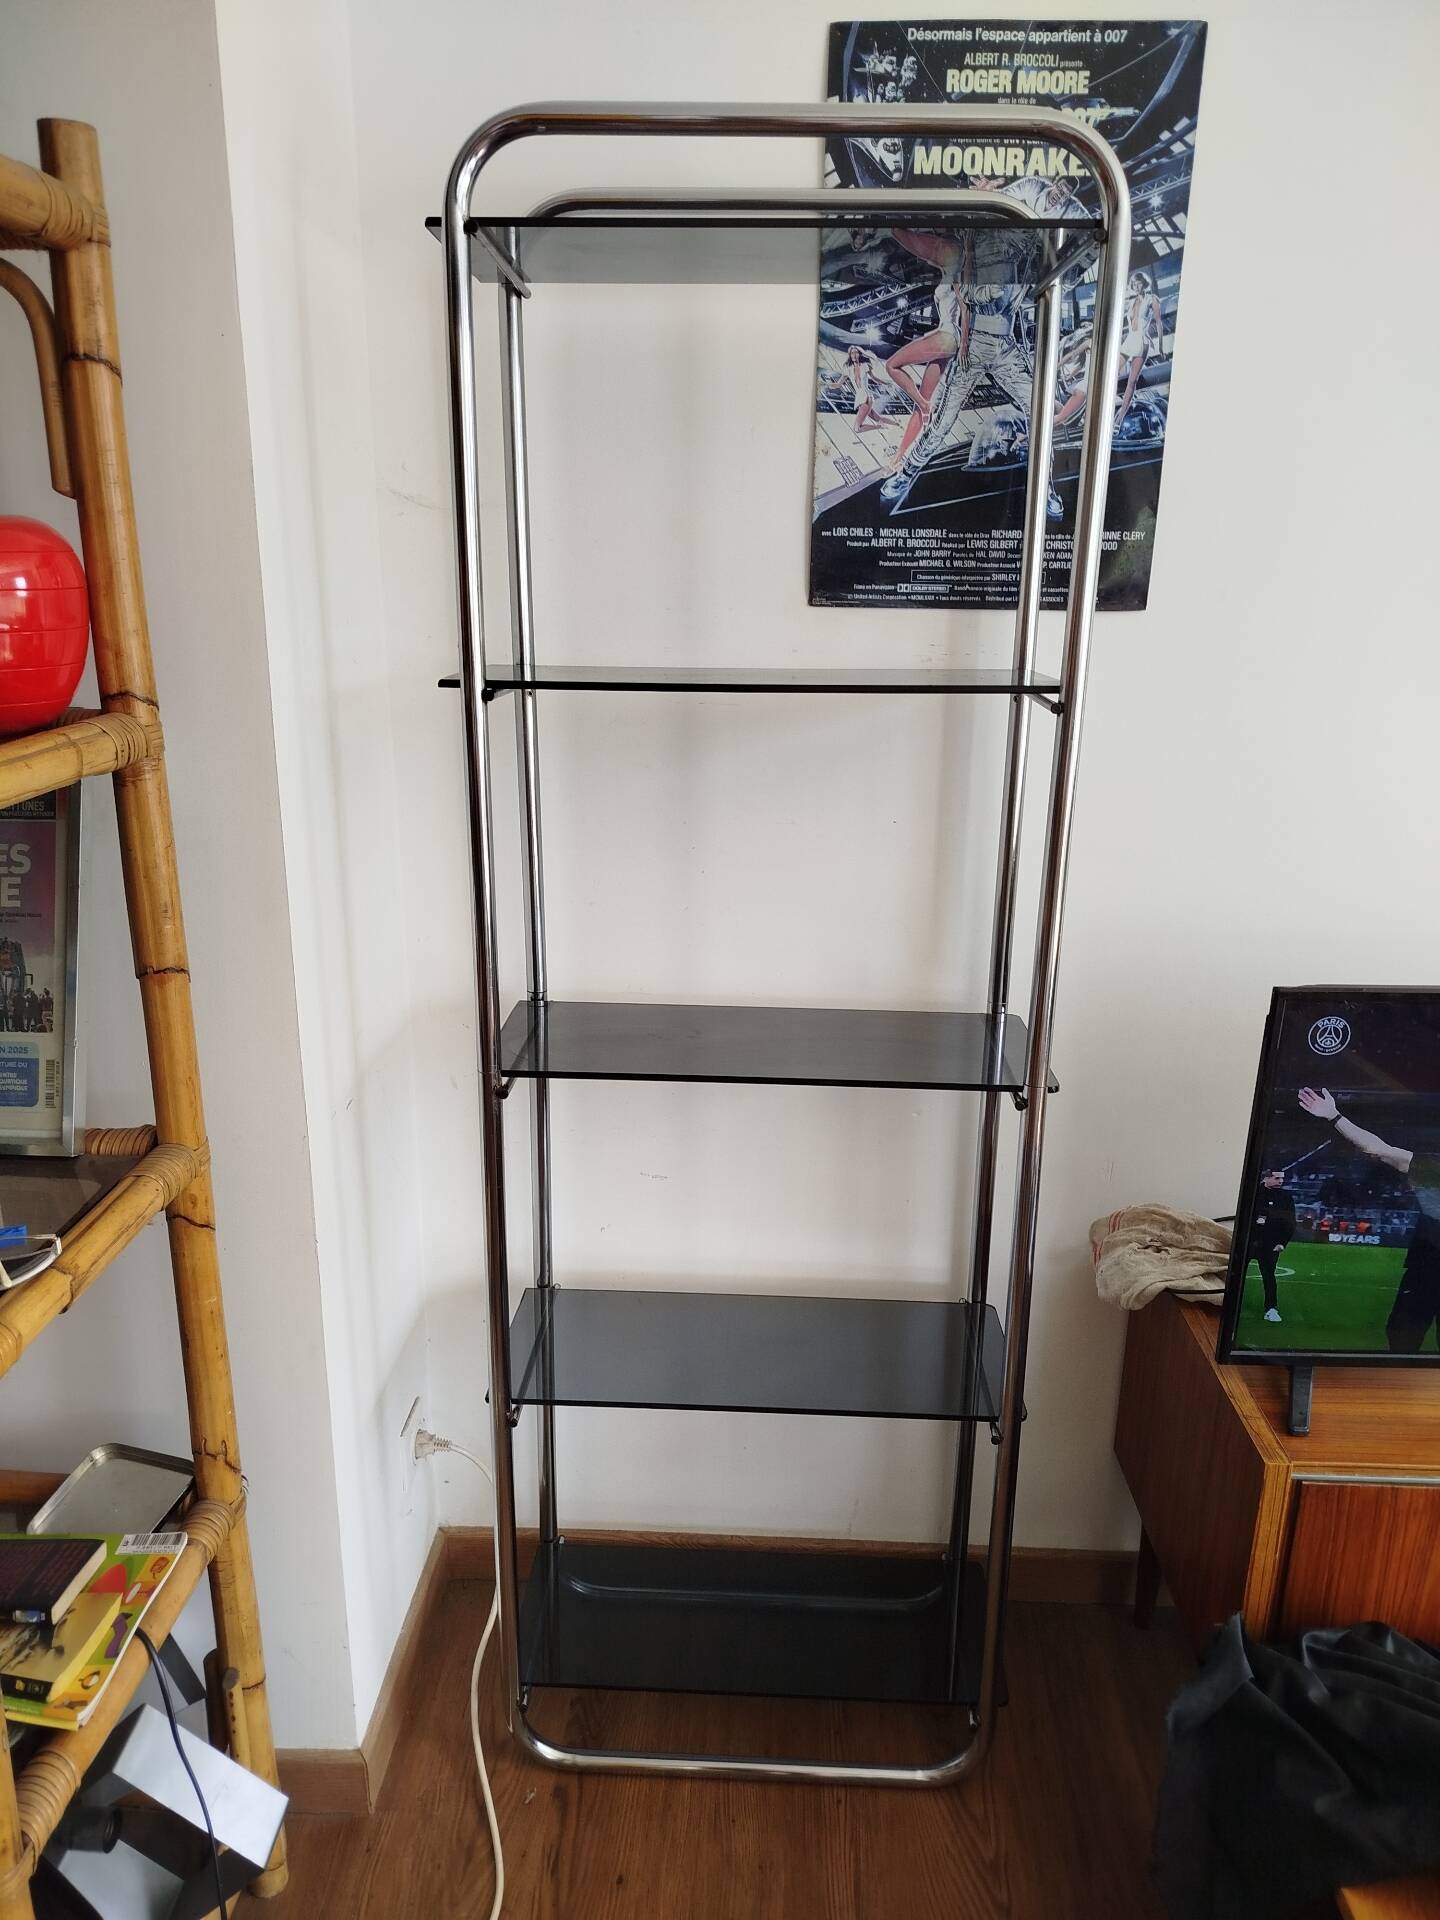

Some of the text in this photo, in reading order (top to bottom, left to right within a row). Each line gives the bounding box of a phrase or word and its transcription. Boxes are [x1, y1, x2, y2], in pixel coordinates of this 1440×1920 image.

[907, 27, 1128, 45] Désormais l'espace appartient à 007
[963, 52, 999, 65] ALBERT
[1001, 53, 1010, 65] R.
[1013, 53, 1059, 67] BROCCOLI
[946, 69, 1090, 95] ROGER MOORE
[913, 145, 1091, 177] MOONRAKE
[832, 527, 848, 537] LOIS
[849, 527, 874, 537] CHILES
[879, 528, 910, 538] MICHAEL
[911, 528, 947, 538] LONSDALE
[991, 529, 1022, 539] RICHARD
[1122, 531, 1146, 541] CLERY
[870, 539, 896, 547] ALBERT
[897, 539, 905, 547] R.
[906, 540, 940, 548] BROCCOLI
[966, 540, 988, 549] LEWIS
[989, 540, 1019, 549] GILBERT
[1101, 541, 1118, 550] OOD
[931, 550, 951, 558] BARRY
[975, 550, 987, 558] HAL
[953, 560, 976, 568] WILSON
[991, 573, 1016, 581] SHIRLEY
[1317, 1018, 1346, 1029] PARIS
[1342, 1234, 1380, 1245] YEARS
